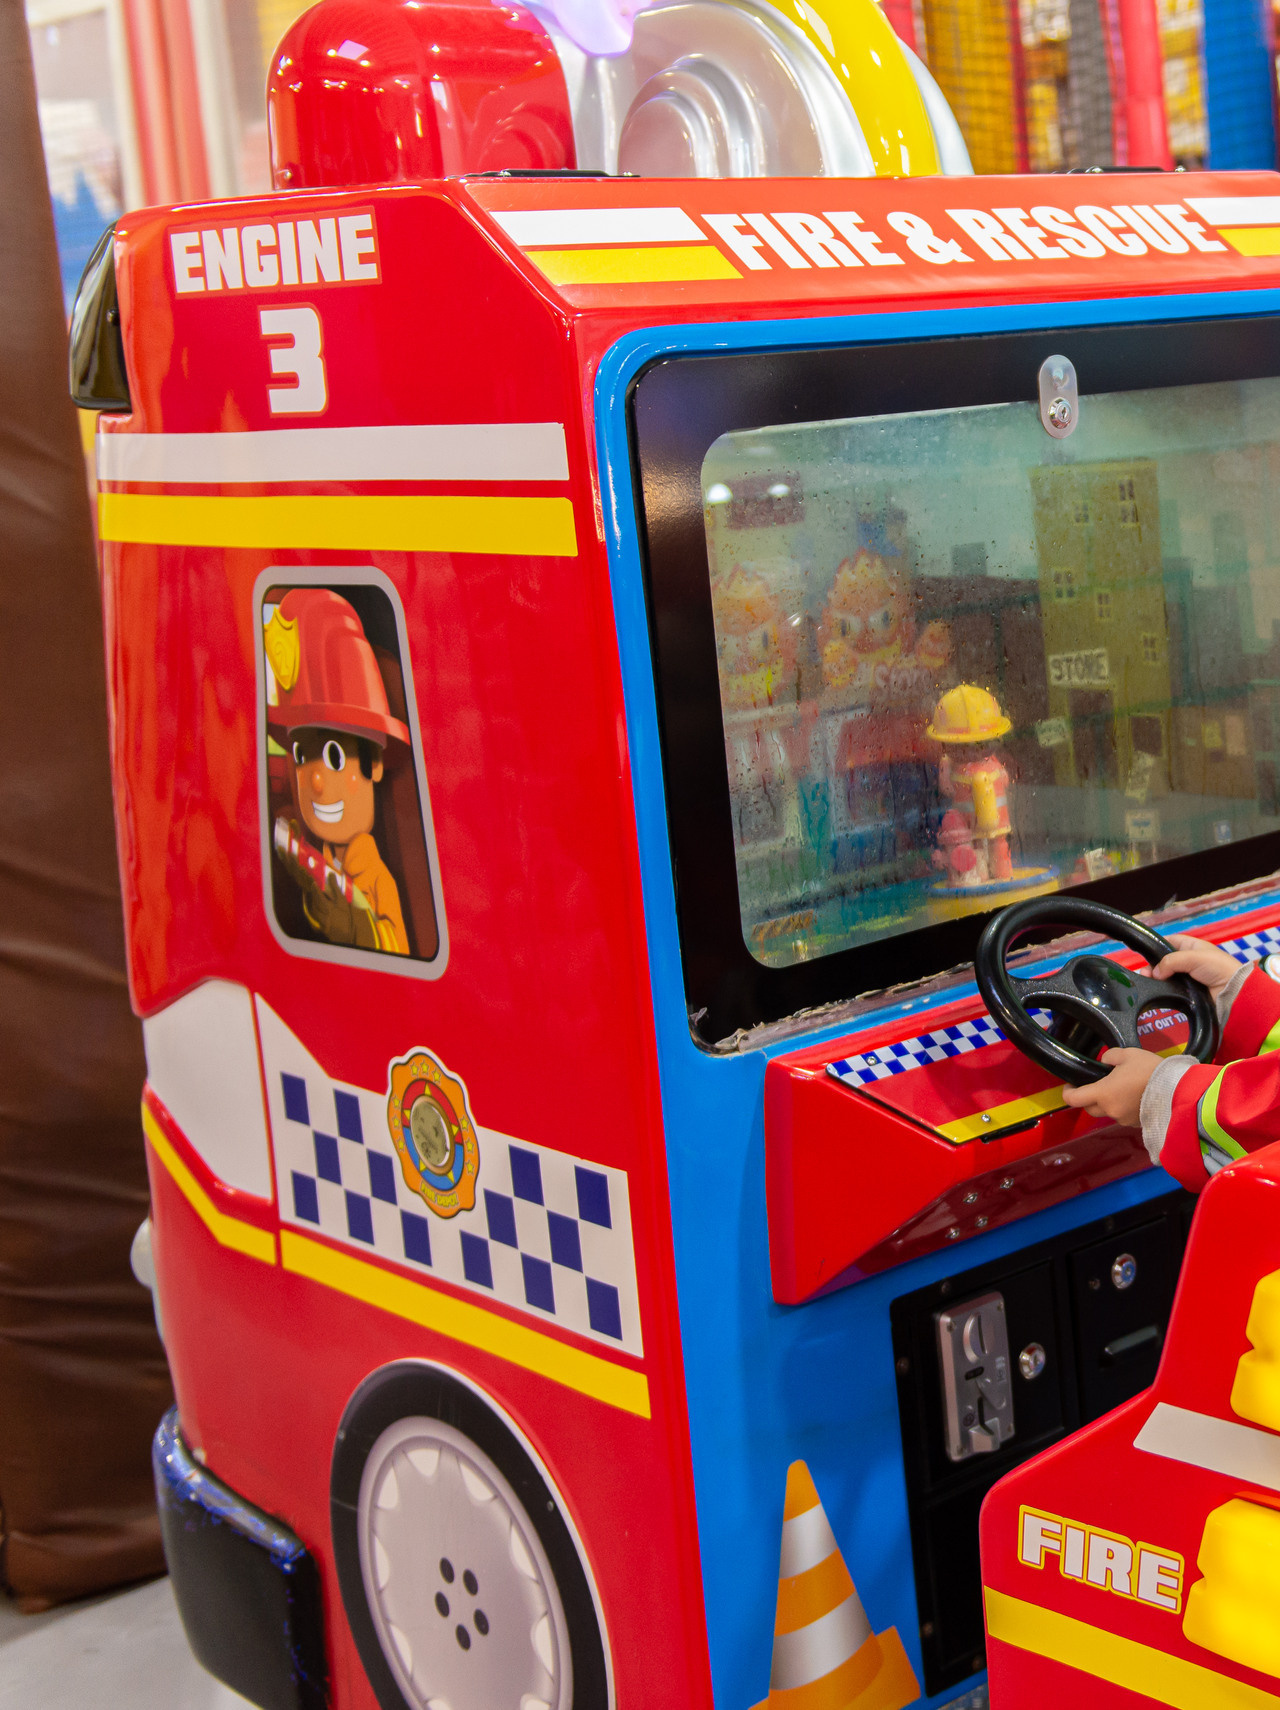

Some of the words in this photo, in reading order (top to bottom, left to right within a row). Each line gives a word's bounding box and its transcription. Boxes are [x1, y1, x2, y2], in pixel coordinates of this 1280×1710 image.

[170, 213, 379, 294] ENGINE
[703, 210, 906, 271] FIRE
[886, 211, 975, 265] &
[945, 203, 1229, 261] RESCUE
[259, 307, 328, 414] 3
[1155, 1016, 1174, 1030] OUT
[1174, 1012, 1188, 1023] TH
[1019, 1508, 1183, 1613] FIRE
